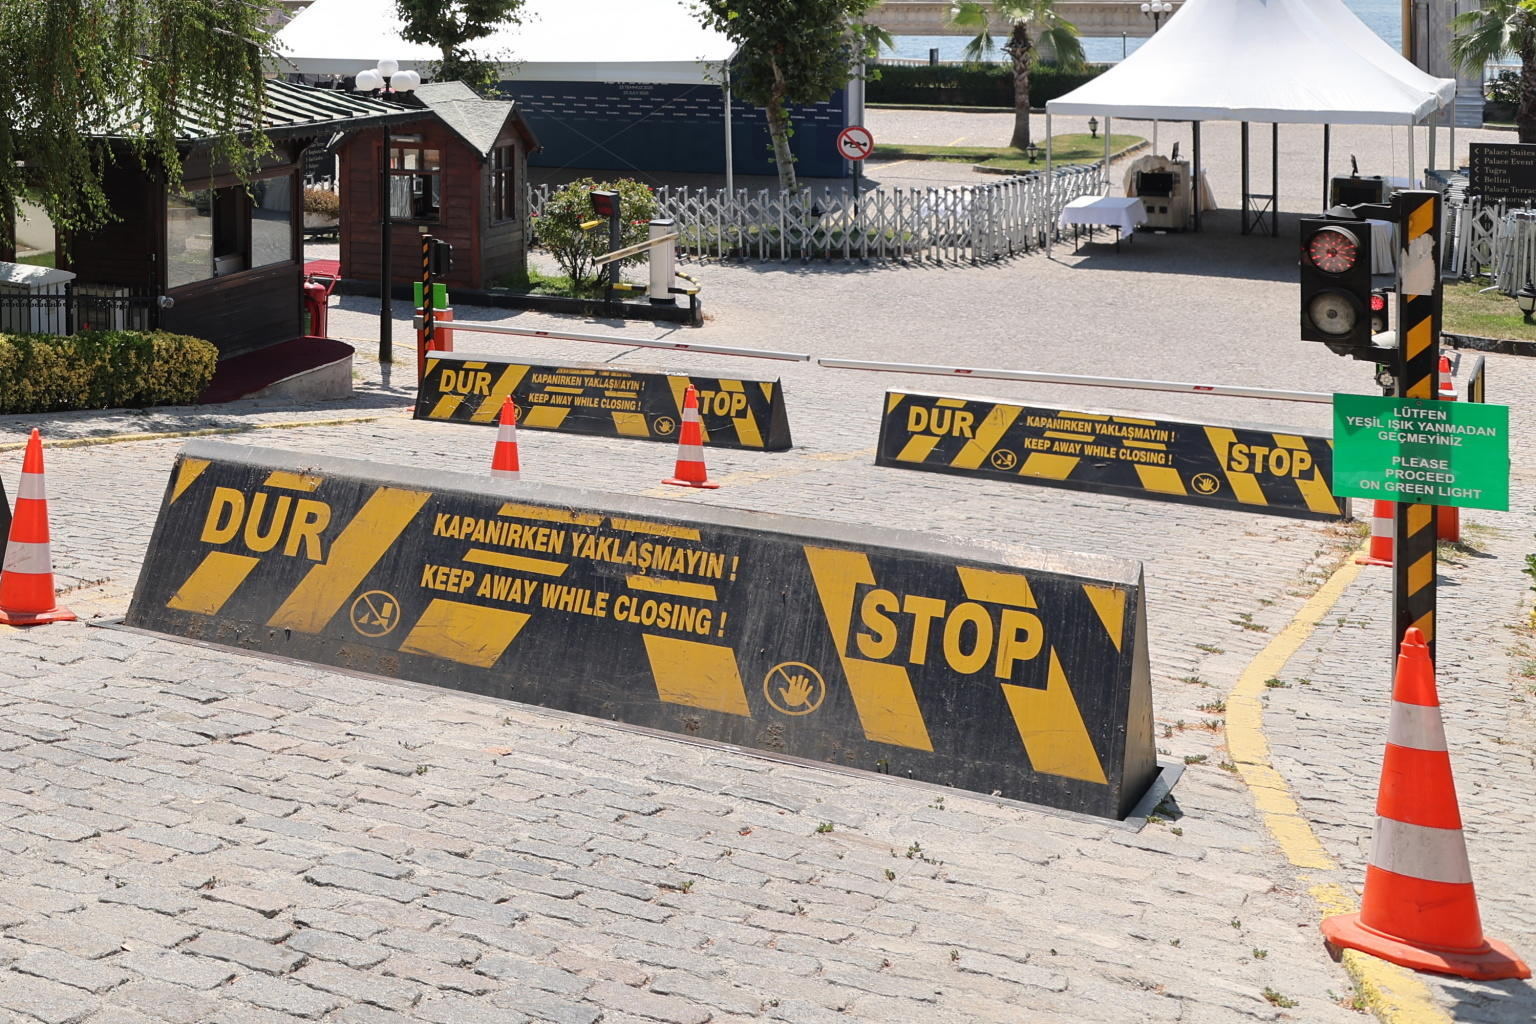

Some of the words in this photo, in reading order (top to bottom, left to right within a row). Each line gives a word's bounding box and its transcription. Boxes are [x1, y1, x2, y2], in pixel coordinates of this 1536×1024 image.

[1484, 147, 1509, 156] Palace
[1510, 148, 1536, 156] Suites
[1484, 157, 1509, 165] Palace
[1511, 158, 1534, 166] Event
[1484, 176, 1511, 184] Bellini
[1484, 185, 1509, 193] Palace
[438, 369, 492, 395] DUR
[531, 373, 582, 386] KAPANIRKEN
[528, 392, 549, 403] KEEP
[550, 394, 572, 406] AWAY
[574, 396, 599, 408] WHILE
[601, 398, 637, 410] CLOSING
[907, 405, 976, 439] DUR
[1393, 405, 1447, 420] LÜTFEN
[1026, 415, 1093, 433] KAPANIRKEN
[1095, 419, 1169, 442] YAKLAŞMAYIN
[1346, 415, 1384, 430] YEŞİL
[1387, 419, 1414, 432] IŞIK
[1417, 422, 1497, 437] YANMADAN
[1377, 430, 1463, 447] GEÇMEYİNİZ
[1024, 437, 1052, 451] KEEP
[1053, 439, 1082, 454] AWAY
[1084, 444, 1117, 459] WHILE
[1119, 448, 1167, 465] CLOSING
[1230, 443, 1312, 478] STOP
[1392, 456, 1449, 470] PLEASE
[1385, 468, 1455, 484] PROCEED
[1359, 479, 1381, 490] ON
[1384, 481, 1434, 496] GREEN
[1438, 486, 1482, 499] LIGHT
[200, 486, 332, 561] DUR
[432, 512, 565, 555] KAPANIRKEN
[570, 532, 725, 579] YAKLAŞMAYIN
[420, 563, 475, 594] KEEP
[476, 572, 539, 605] AWAY
[541, 581, 610, 618] WHILE
[614, 595, 712, 635] CLOSING
[856, 588, 1044, 680] STOP
